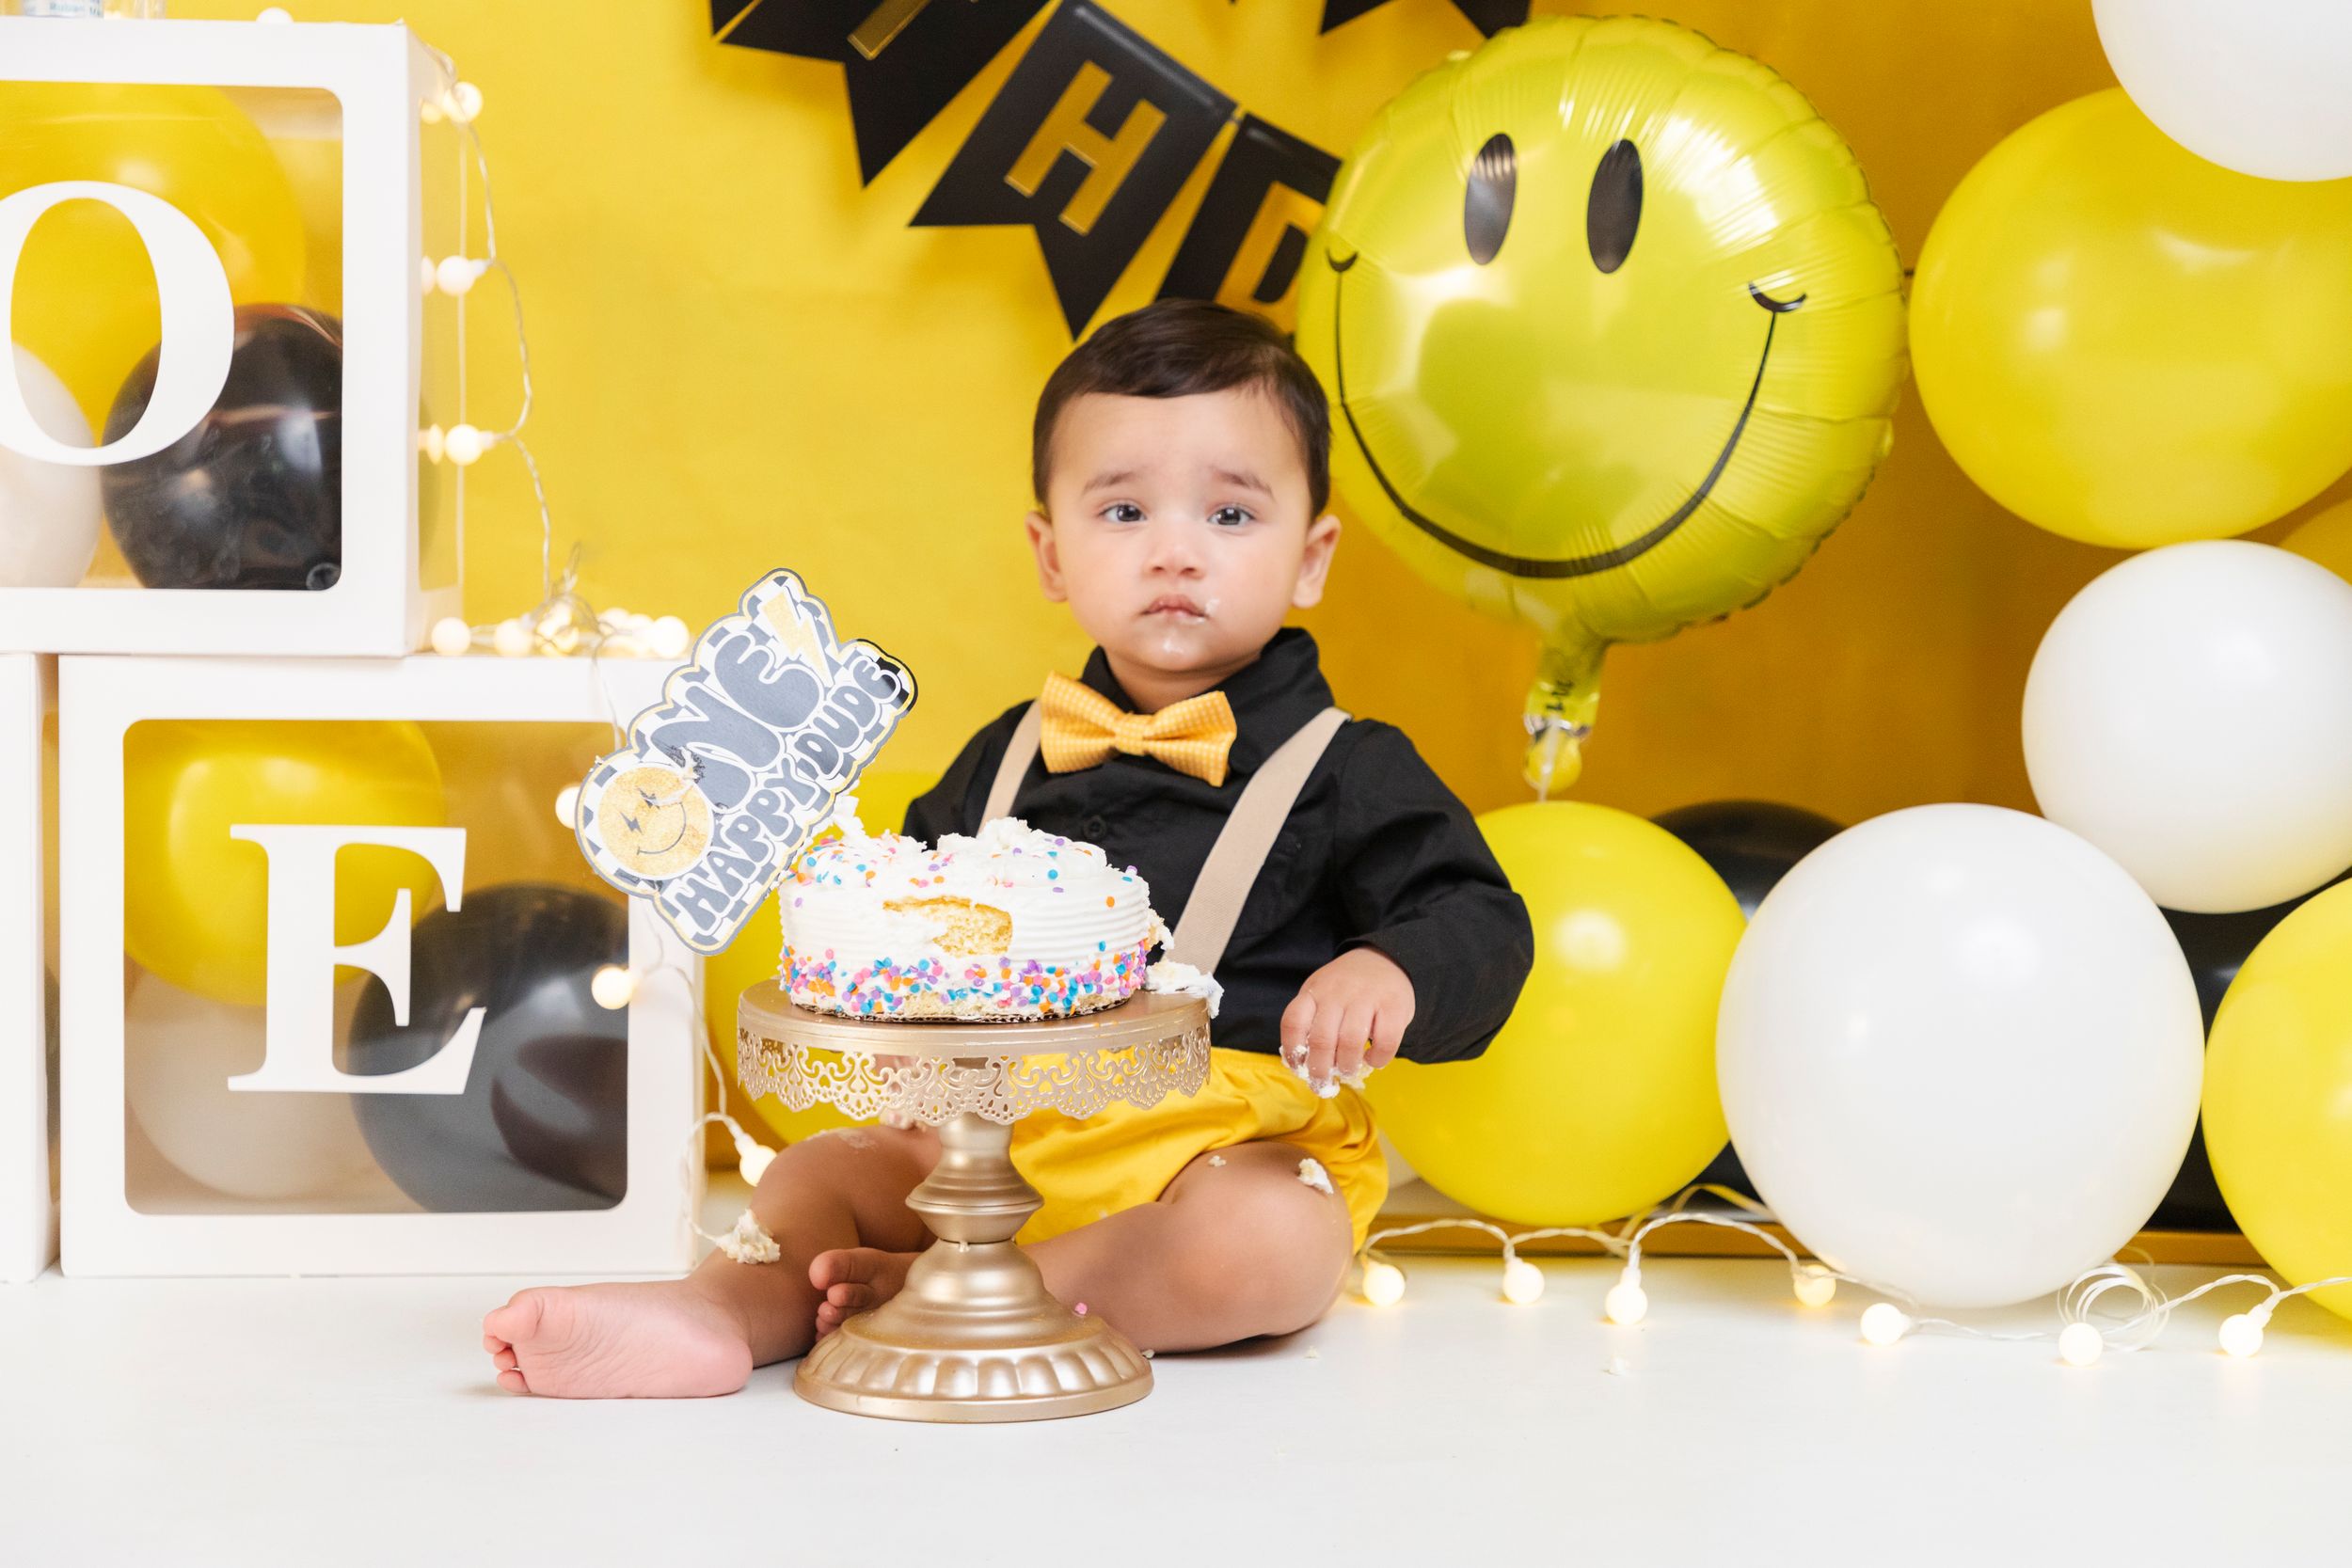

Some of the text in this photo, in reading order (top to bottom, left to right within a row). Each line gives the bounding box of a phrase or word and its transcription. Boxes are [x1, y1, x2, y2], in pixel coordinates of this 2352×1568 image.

[0, 180, 234, 466] O
[672, 654, 902, 934] HAPPY DUDE
[228, 824, 486, 1095] E
